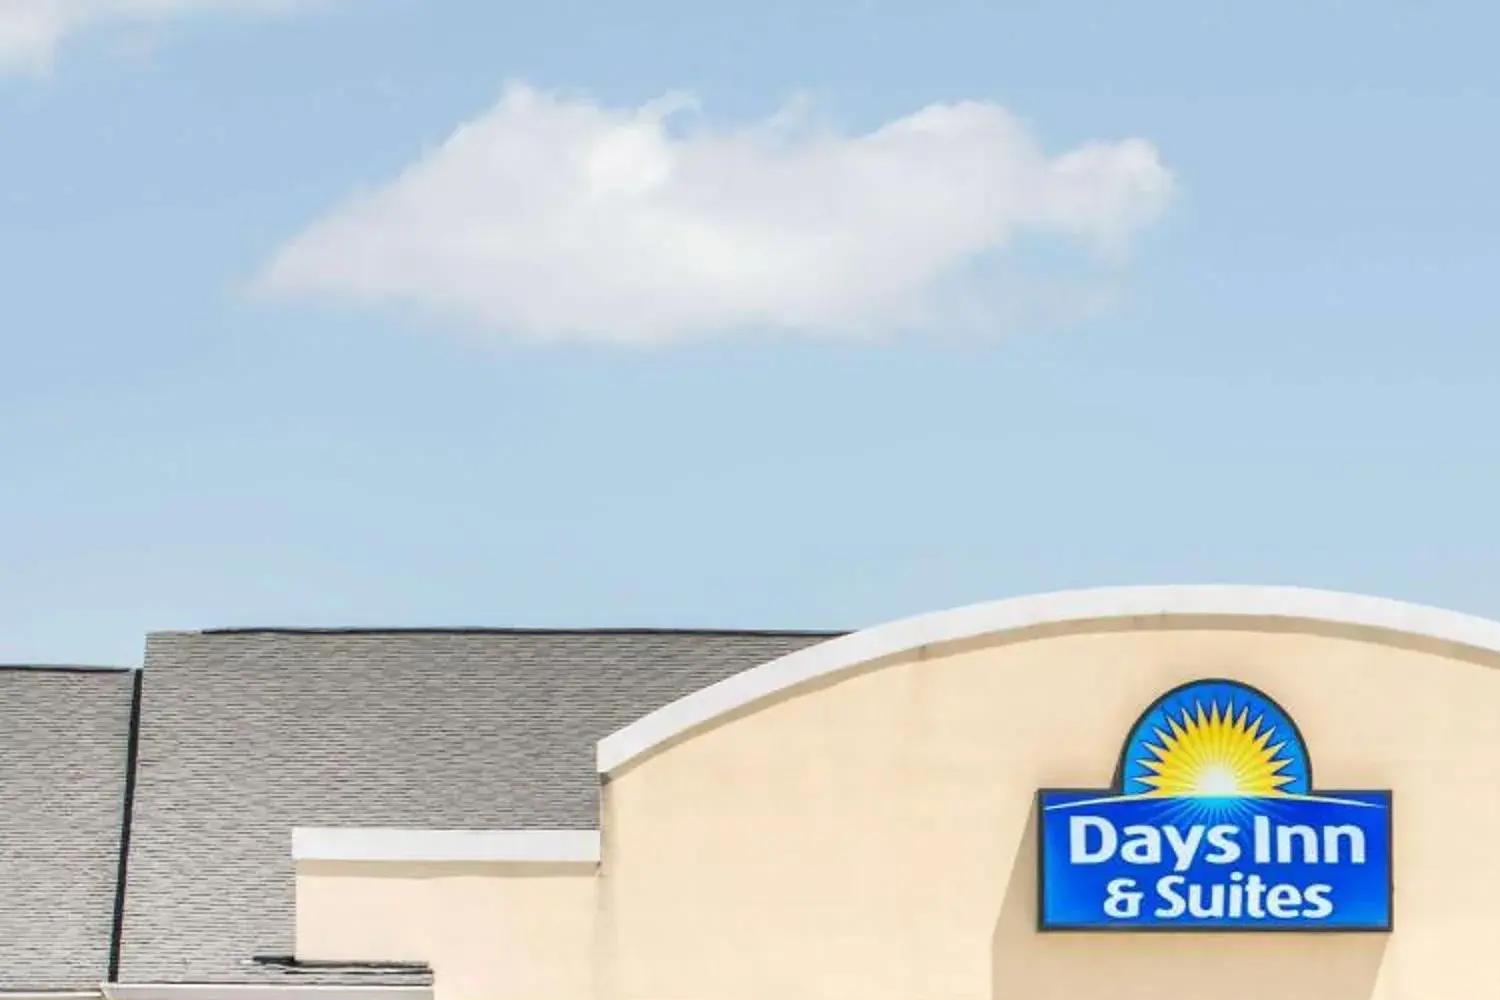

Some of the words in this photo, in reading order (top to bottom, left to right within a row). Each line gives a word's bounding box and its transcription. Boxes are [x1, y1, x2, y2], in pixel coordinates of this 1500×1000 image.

[1070, 815, 1241, 871] Days
[1254, 815, 1365, 864] Inn
[1103, 878, 1143, 918] &
[1155, 871, 1333, 918] Suites
